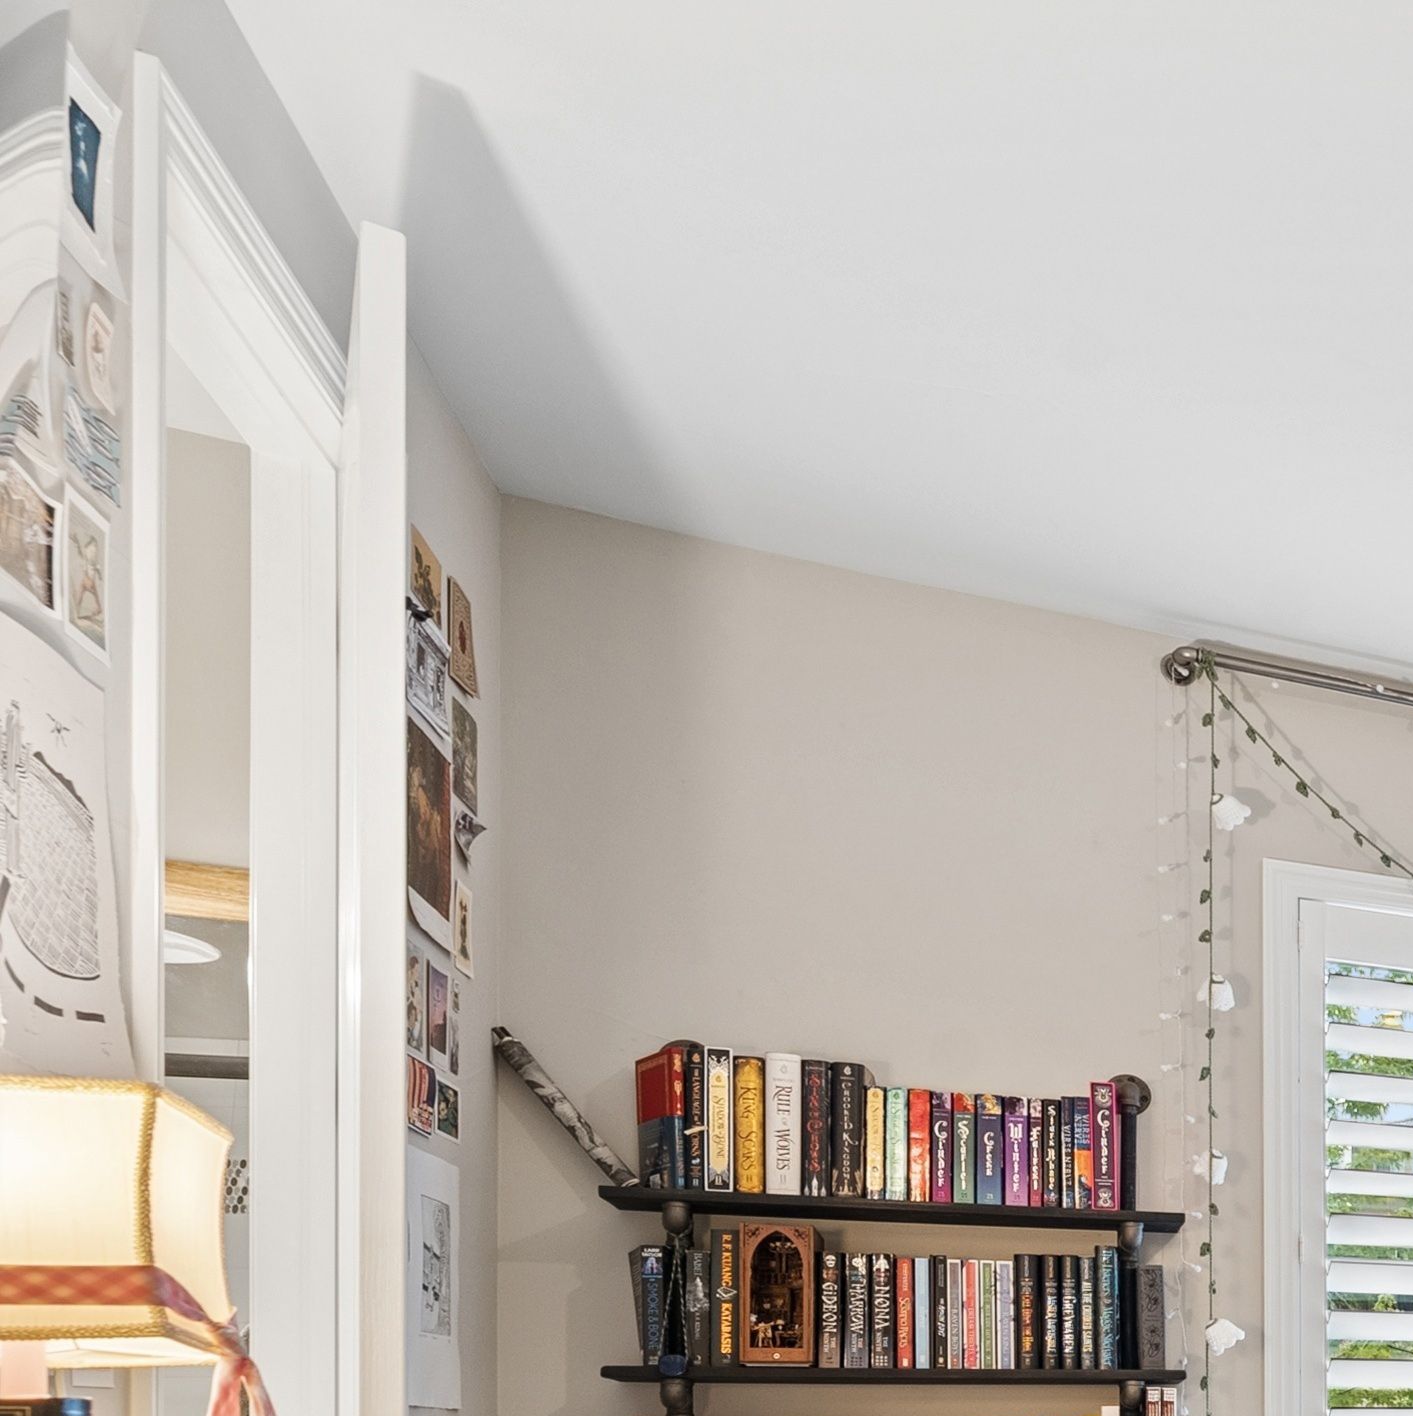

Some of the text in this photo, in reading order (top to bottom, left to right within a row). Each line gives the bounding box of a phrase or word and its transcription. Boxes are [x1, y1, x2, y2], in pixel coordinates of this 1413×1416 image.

[773, 1085, 796, 1170] RULE WOLVES
[1096, 1110, 1111, 1174] Cinder
[720, 1302, 732, 1354] KATABASIS
[822, 1282, 838, 1332] GIDEON
[848, 1279, 865, 1334] HARROW
[874, 1286, 890, 1329] NONA
